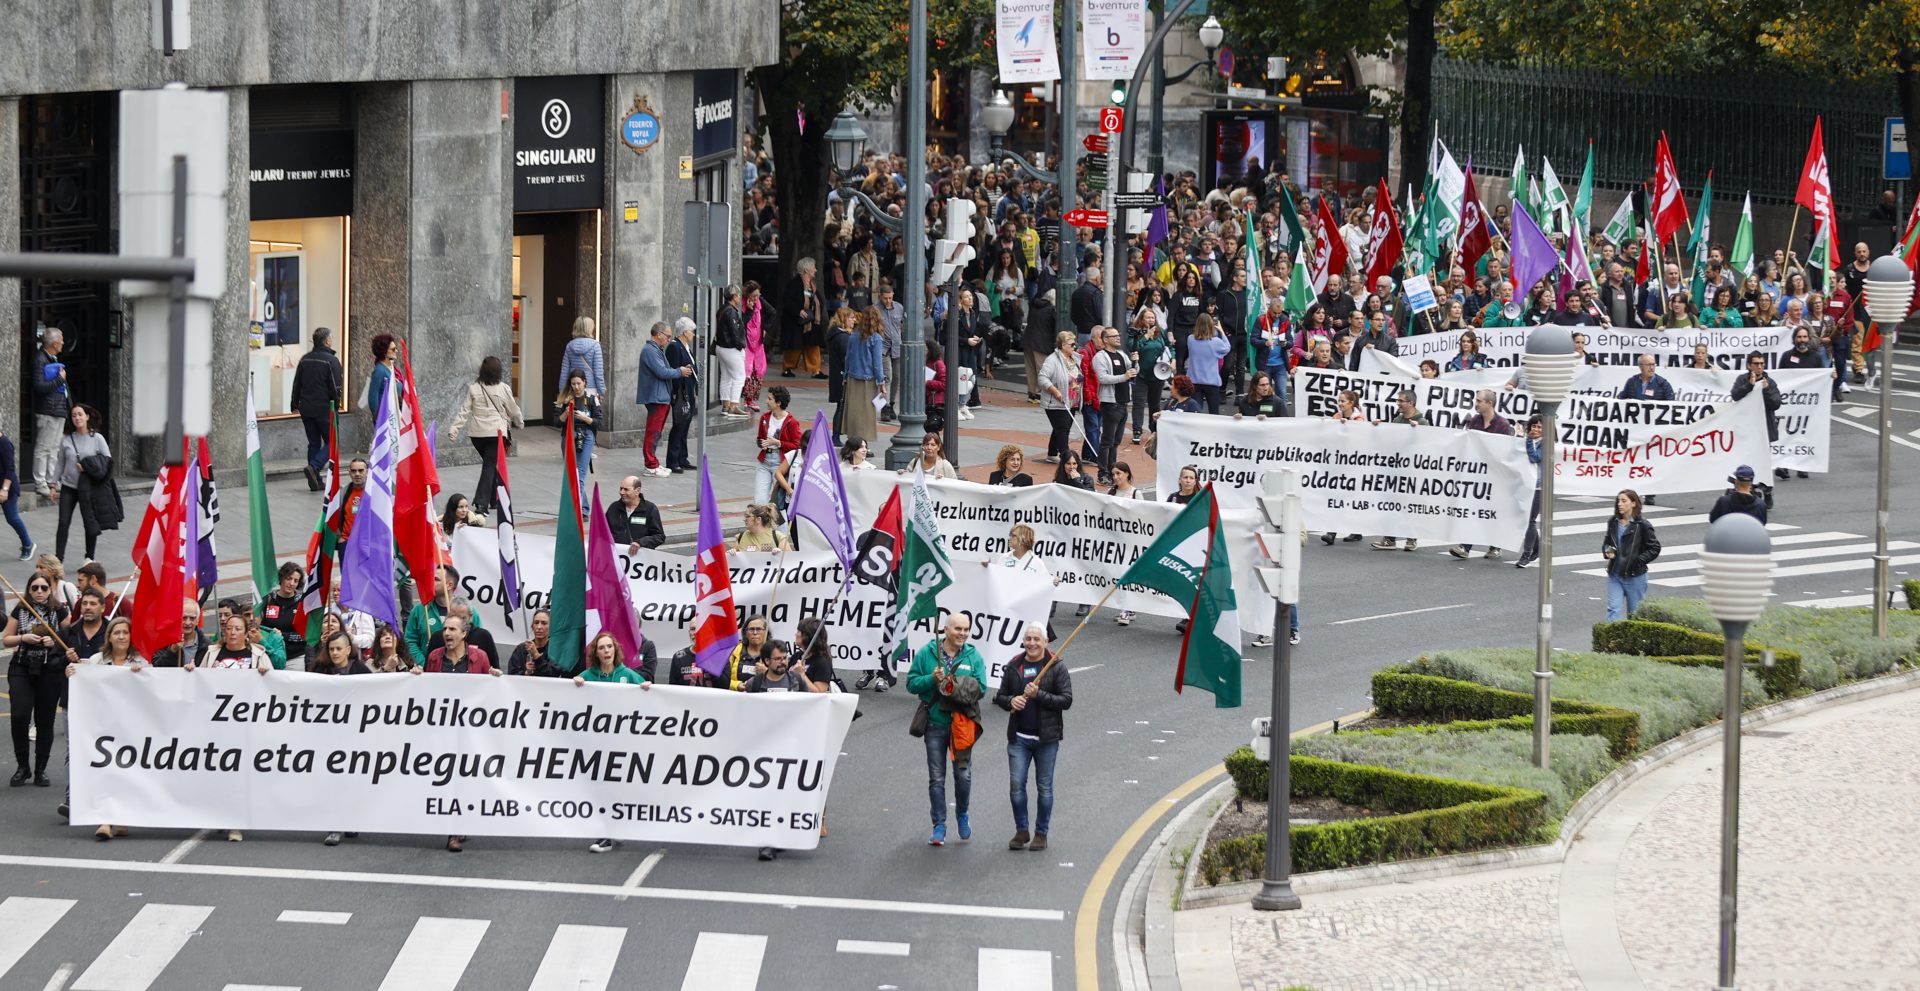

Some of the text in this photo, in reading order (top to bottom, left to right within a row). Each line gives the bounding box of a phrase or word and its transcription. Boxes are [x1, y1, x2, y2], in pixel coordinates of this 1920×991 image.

[628, 120, 653, 128] FEDERICO
[705, 99, 732, 123] DOCKERS
[516, 148, 595, 166] SINGULARU
[249, 169, 351, 182] ULARU TRENDY JEWELS
[526, 174, 585, 184] TRENDY JEWELS
[1423, 333, 1493, 357] publikak
[1598, 332, 1670, 350] enpresa
[1677, 331, 1779, 351] publikoetan
[1569, 398, 1715, 426] INDARTZEKO
[1646, 430, 1734, 458] ADOSTU
[1794, 445, 1815, 455] ESK
[1190, 441, 1488, 474] Zerbitzu publikoak indartzeko Udal Forun
[1576, 465, 1654, 478] SATSE ESK
[1301, 472, 1356, 492] oldata
[1361, 475, 1417, 494] HEMEN
[1419, 478, 1493, 500] ADOSTU!
[1014, 506, 1079, 527] publikoa
[1084, 510, 1154, 536] indartzeko
[1327, 498, 1497, 520] ELA LAB CCOO STEILAS SATSE ESK
[951, 533, 979, 551] eta
[1071, 538, 1125, 565] HEMEN
[1084, 573, 1106, 587] CCOO
[1158, 556, 1196, 582] EUSKAL
[211, 694, 719, 738] Zerbitzu publikoak indartzeko
[90, 736, 242, 772] Soldata
[254, 743, 315, 773] eta
[326, 743, 505, 786] enplegua
[516, 747, 655, 784] HEMEN
[426, 798, 461, 816] ELA
[481, 800, 519, 817] LAB
[537, 801, 593, 818] CCOO
[611, 804, 692, 823] STEILAS
[710, 808, 771, 828] SATSE
